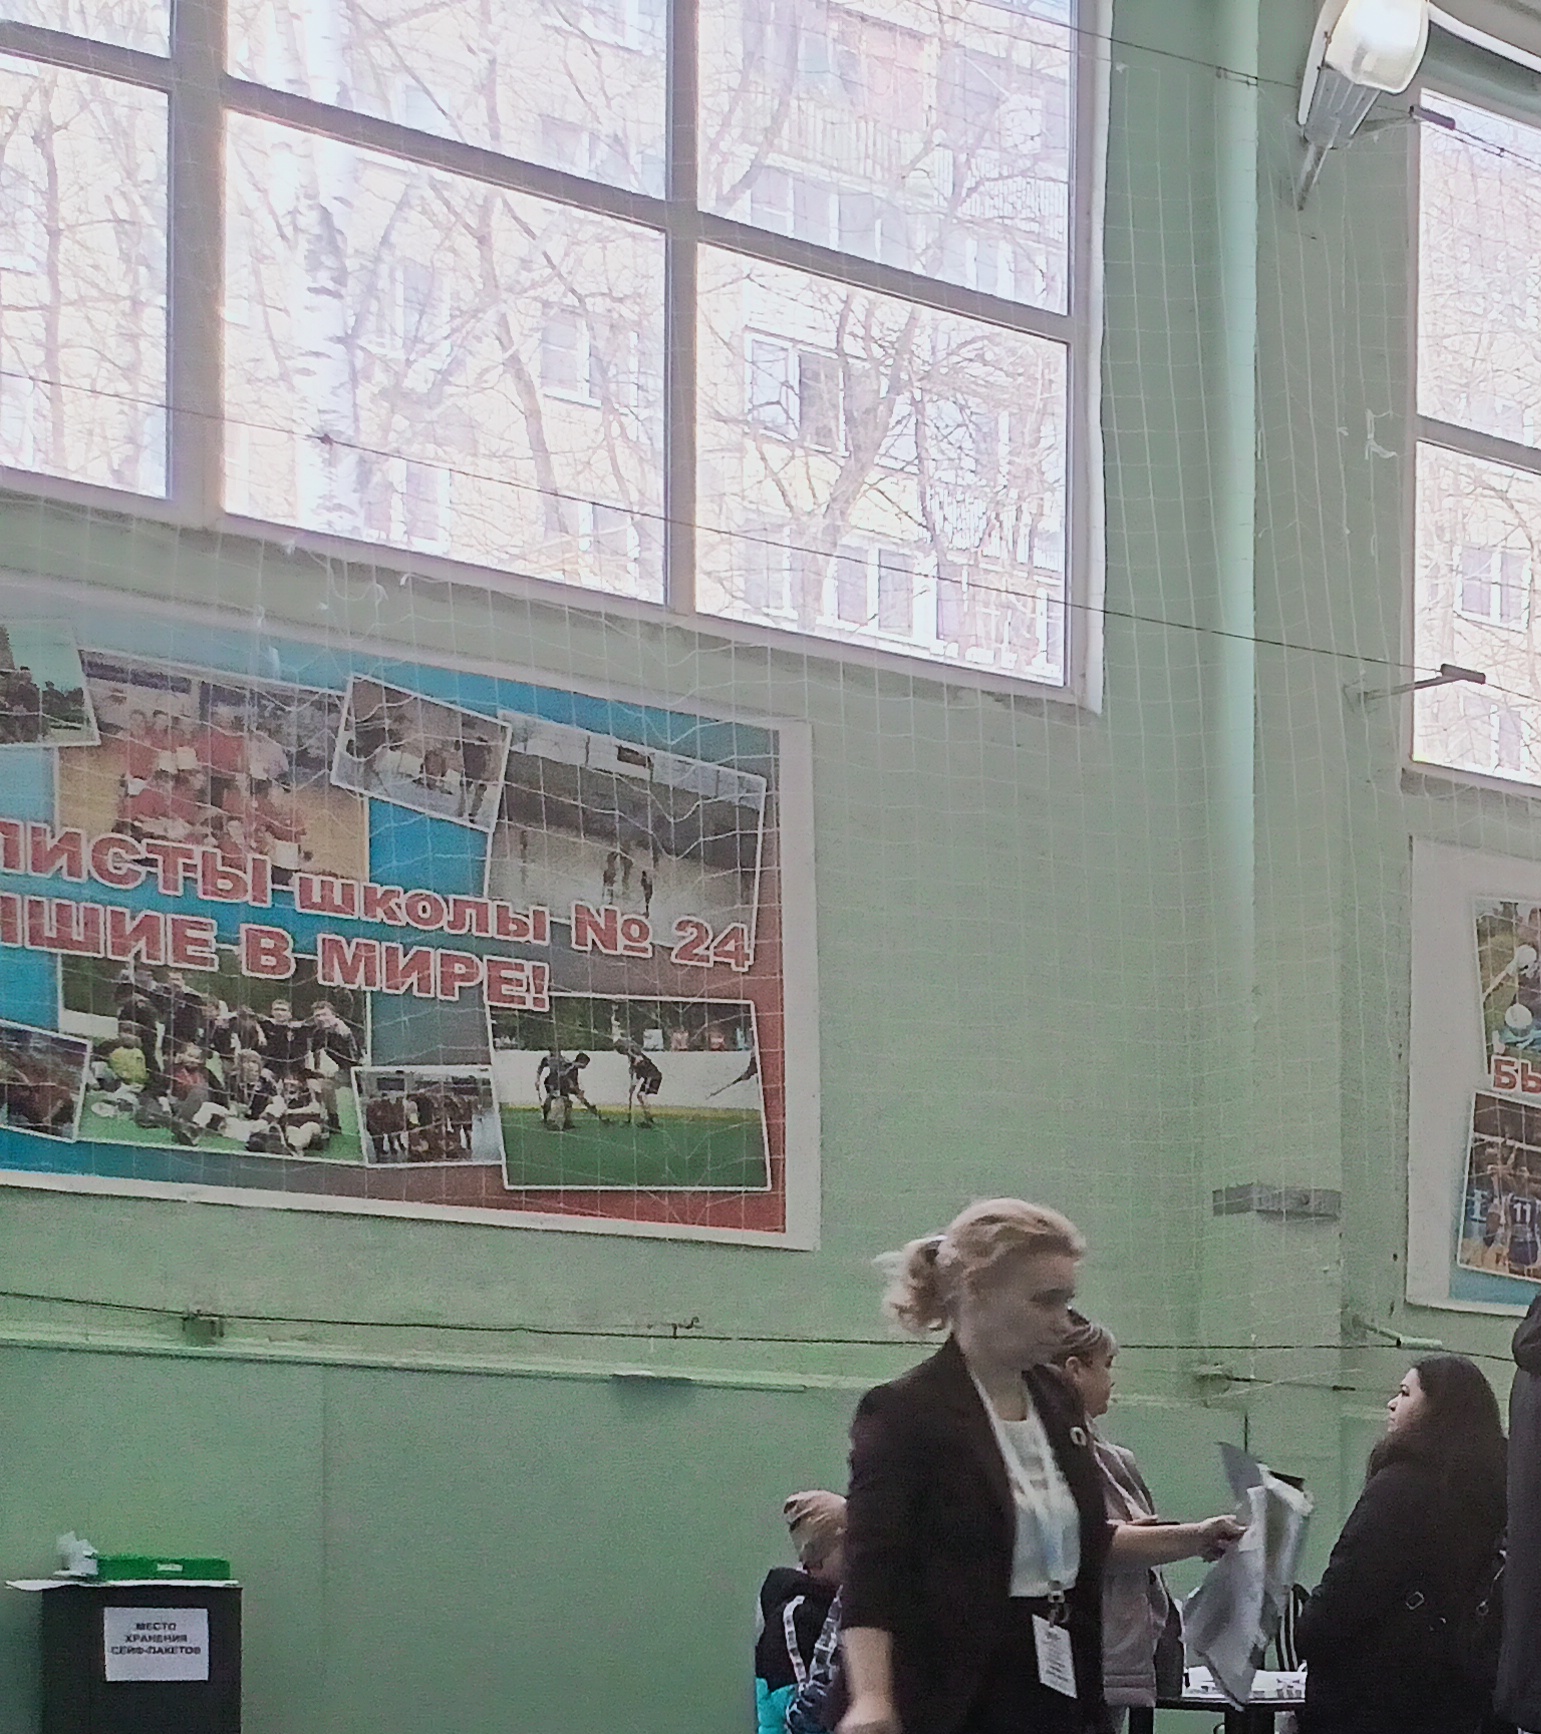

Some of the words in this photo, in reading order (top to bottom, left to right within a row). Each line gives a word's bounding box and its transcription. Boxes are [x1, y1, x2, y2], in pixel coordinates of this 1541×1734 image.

[296, 872, 550, 945] школы
[571, 905, 653, 958] №
[671, 917, 755, 973] 24
[240, 923, 296, 979] В
[317, 933, 551, 1013] МИРЕ!
[136, 1622, 177, 1631] МЕСТО
[125, 1634, 188, 1643] ХРАНЕНИЯ
[111, 1646, 202, 1655] СЕЙФ-ПАКЕТОВ
